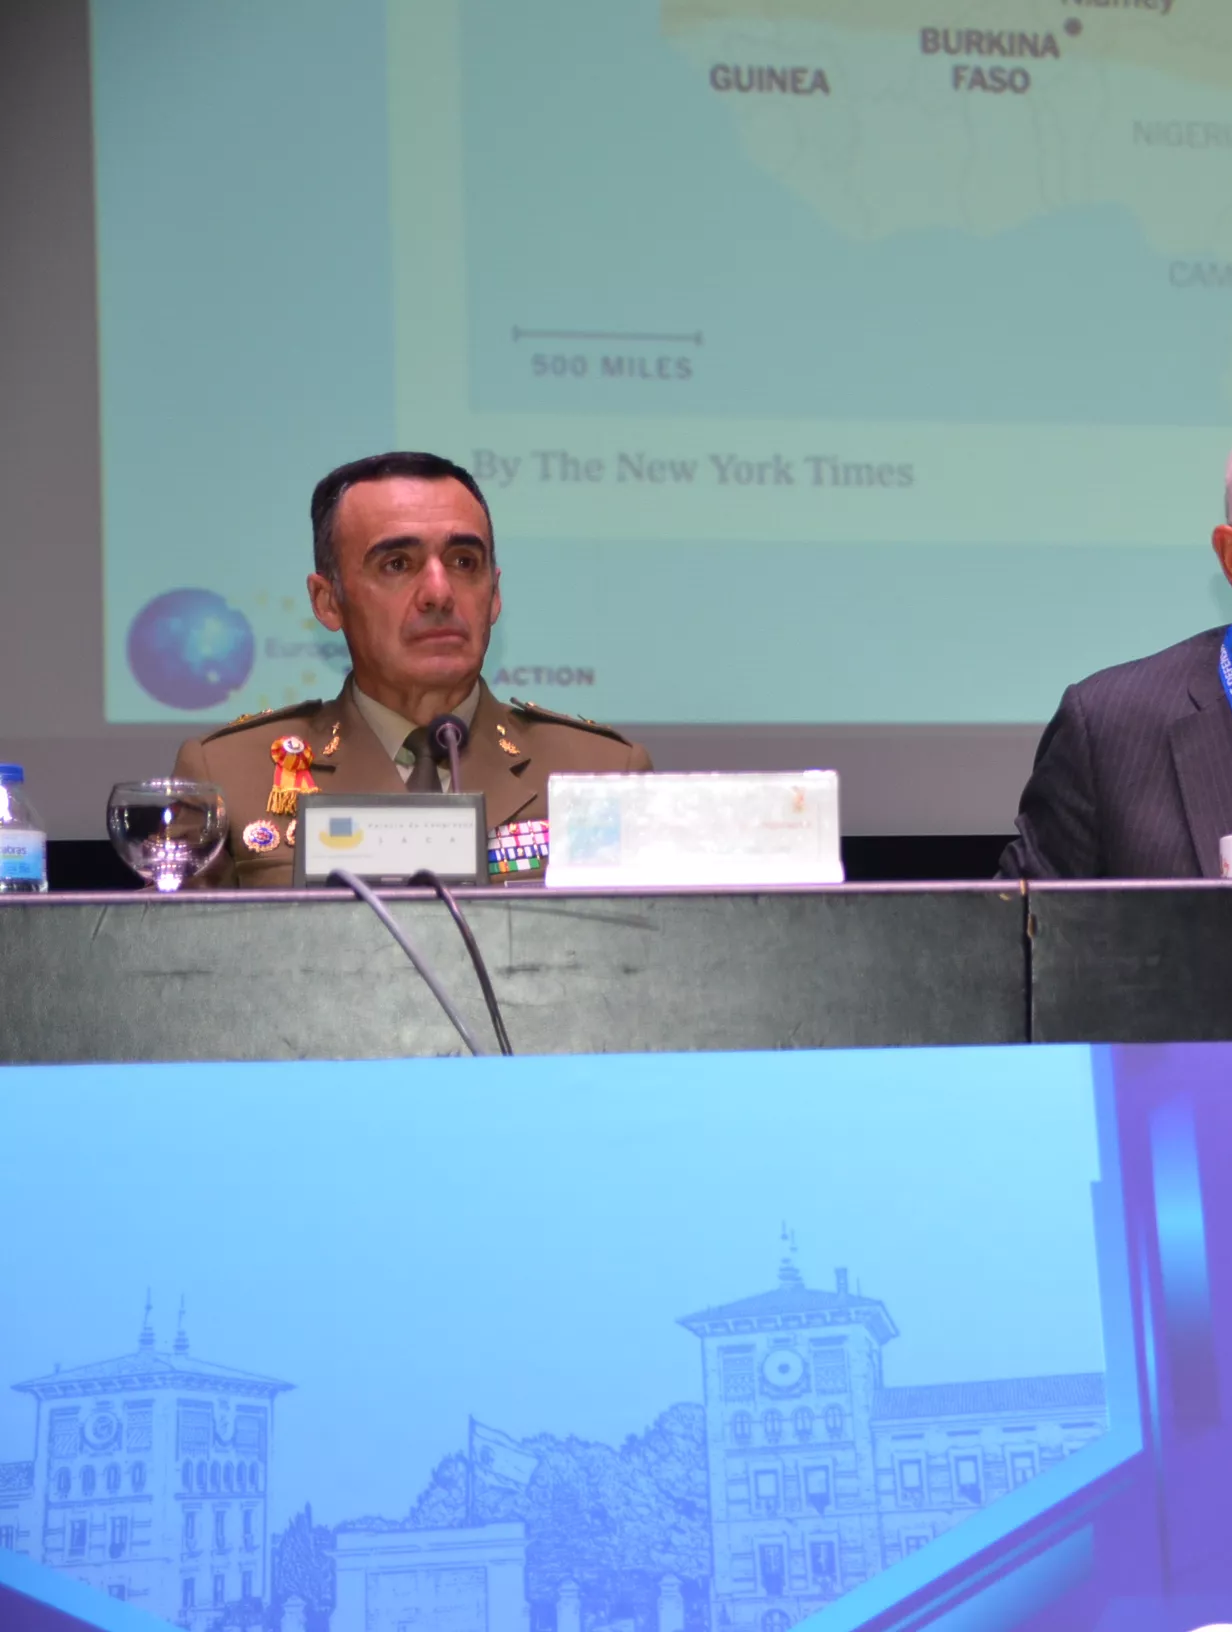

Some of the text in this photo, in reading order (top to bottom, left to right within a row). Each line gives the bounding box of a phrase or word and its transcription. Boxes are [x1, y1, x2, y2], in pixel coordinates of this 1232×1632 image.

[919, 26, 1061, 59] BURKINA
[709, 63, 831, 96] GUINEA
[951, 64, 1032, 95] FASO
[530, 353, 694, 381] 500 MILES
[471, 448, 915, 489] By The New York Times
[494, 665, 596, 687] ACTION
